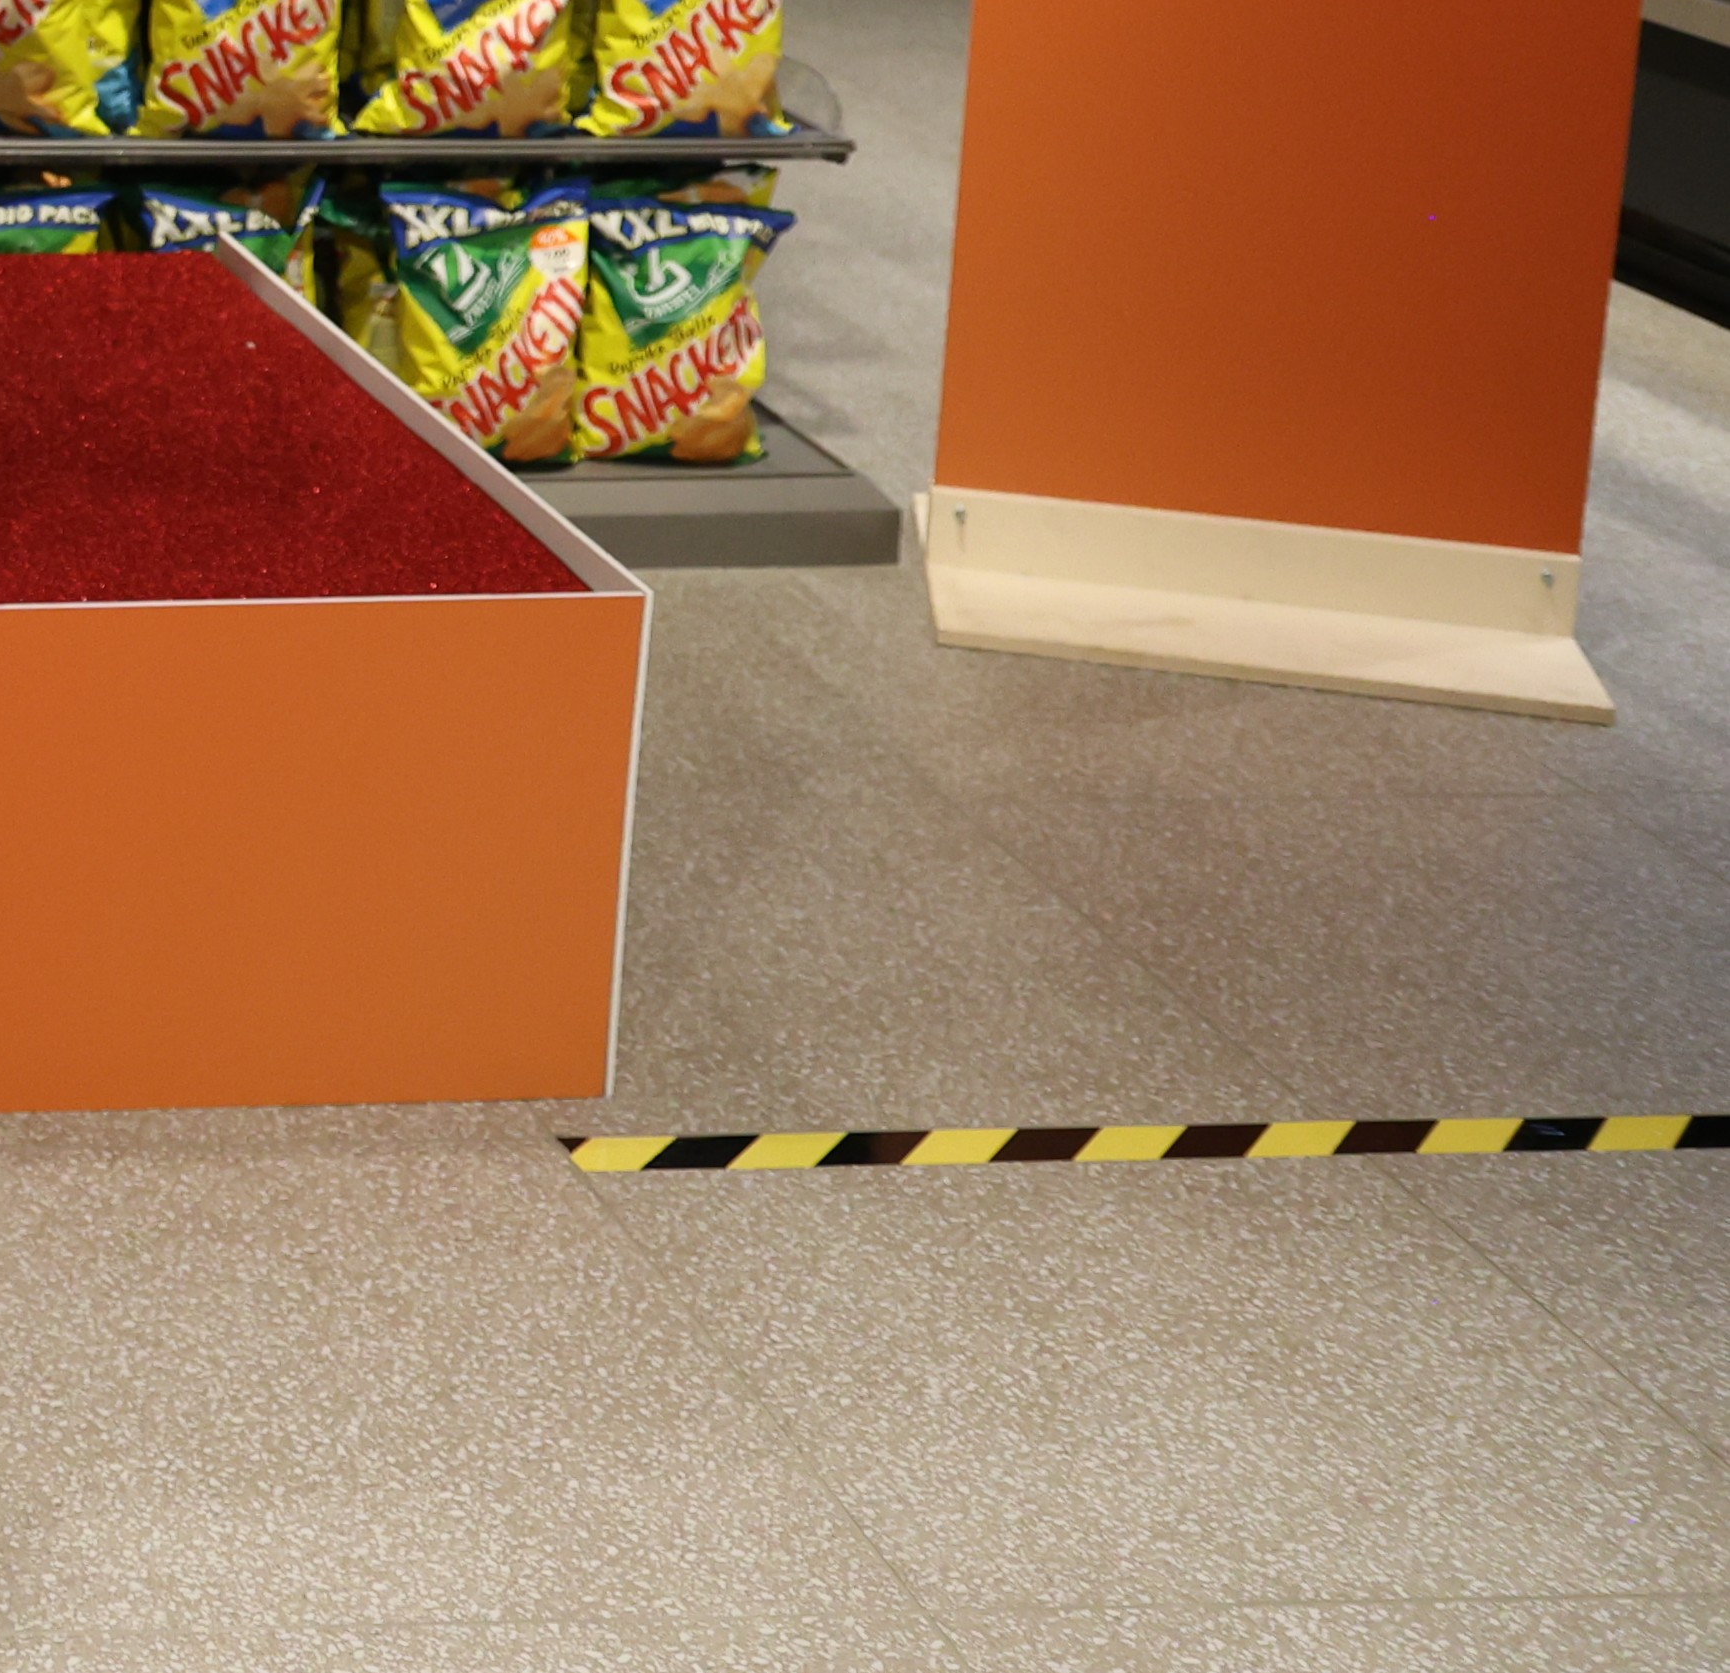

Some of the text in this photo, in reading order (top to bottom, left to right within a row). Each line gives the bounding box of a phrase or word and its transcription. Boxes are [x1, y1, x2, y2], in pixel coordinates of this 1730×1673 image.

[146, 199, 244, 249] XXL
[390, 202, 482, 249] XXL
[430, 276, 584, 439] NACKETTI
